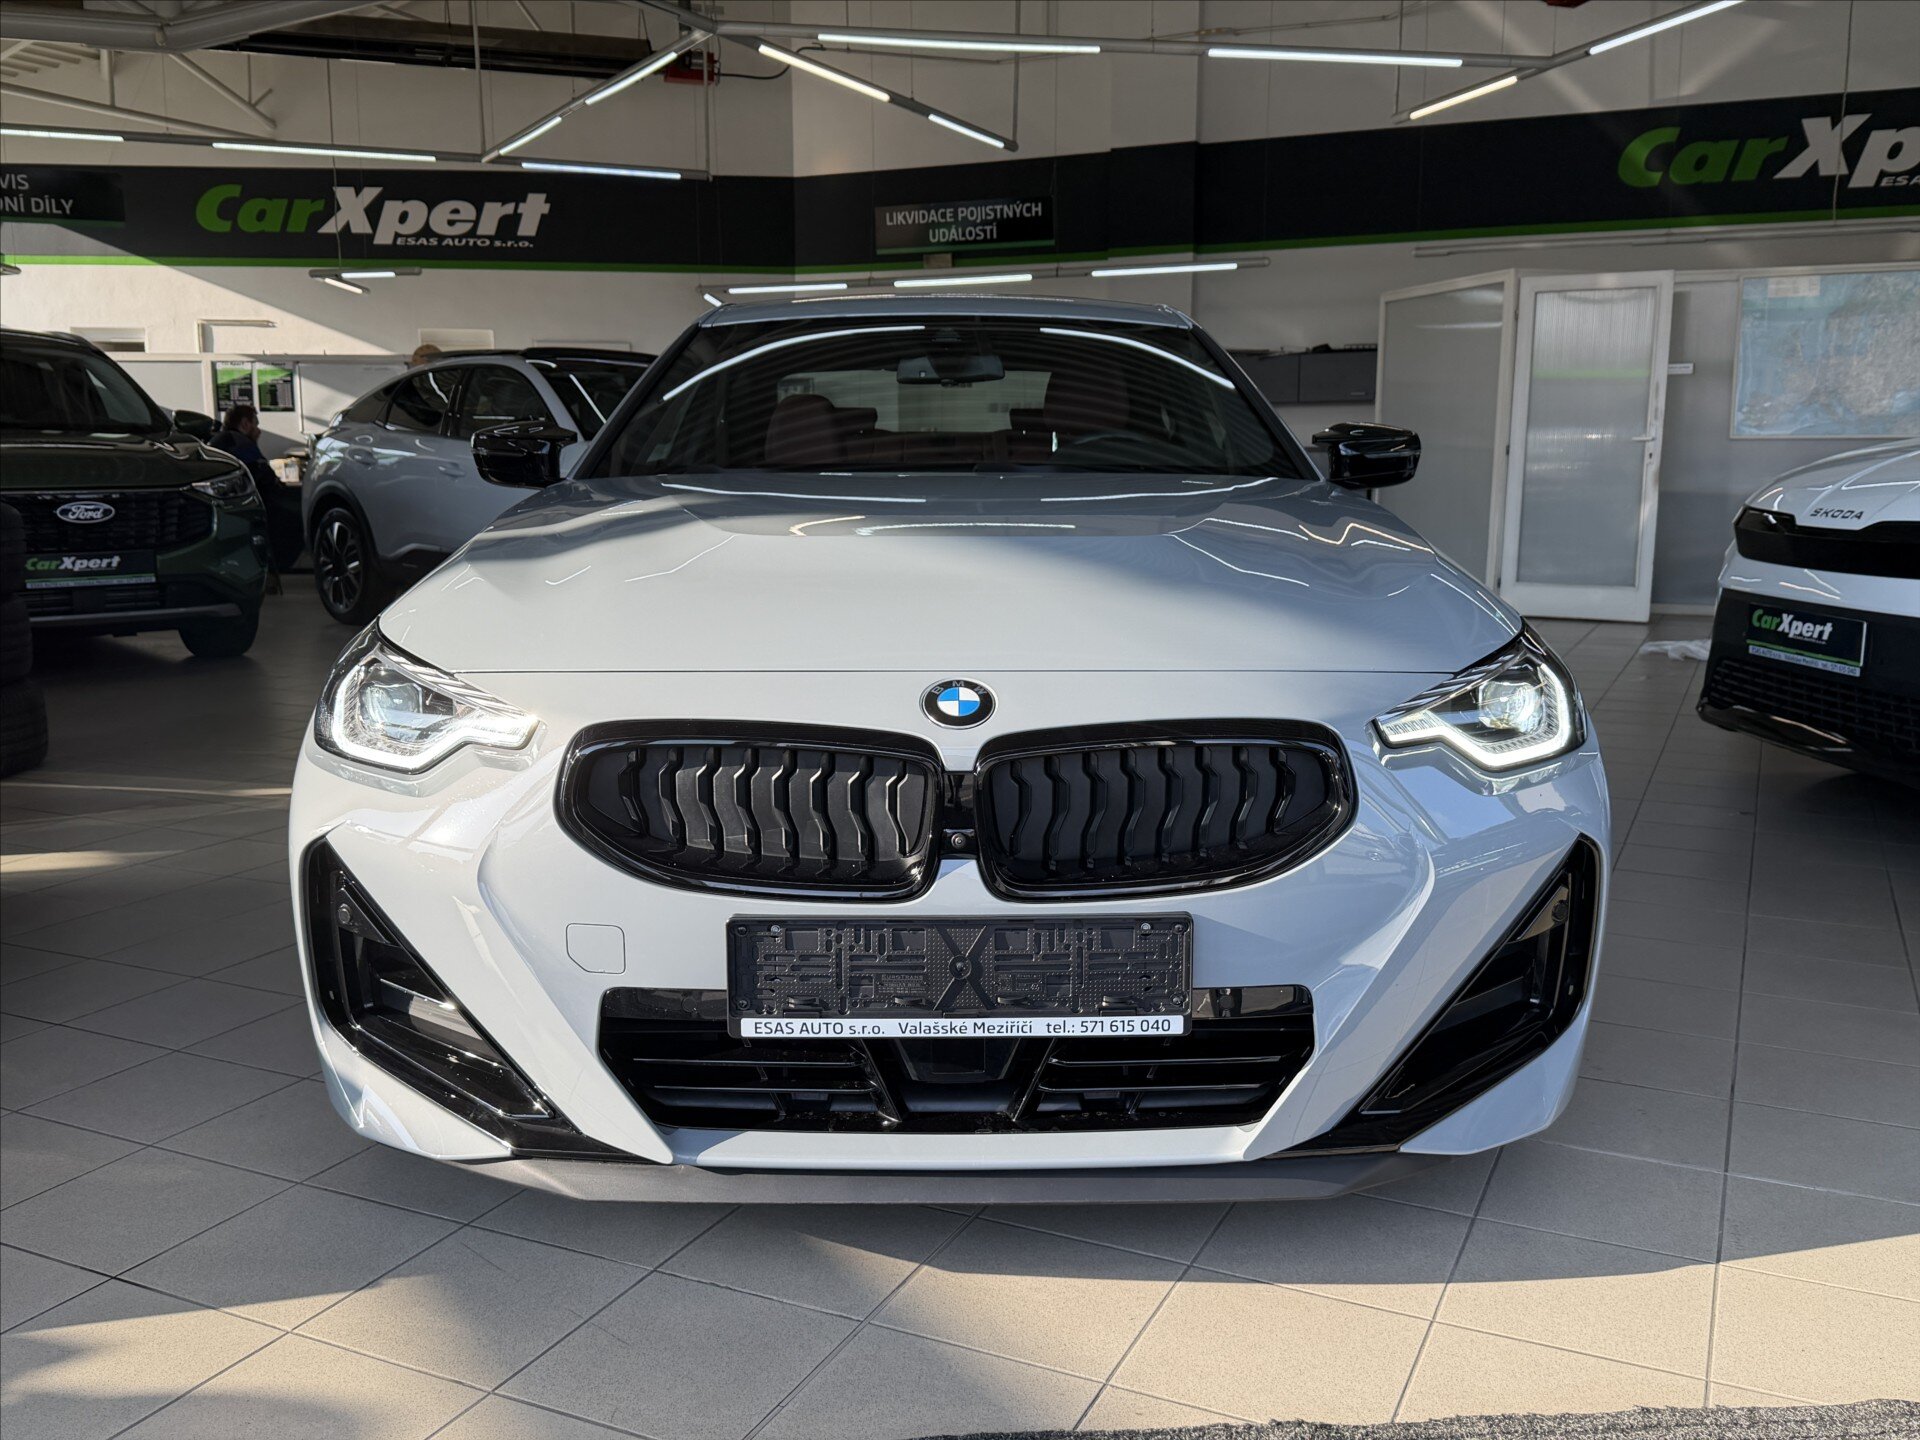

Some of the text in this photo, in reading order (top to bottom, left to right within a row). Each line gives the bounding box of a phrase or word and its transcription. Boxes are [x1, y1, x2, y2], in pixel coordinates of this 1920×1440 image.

[0, 194, 73, 215] NÍ DÍLY
[195, 184, 550, 245] CarXpert
[886, 201, 1042, 226] LIKVIDACE POJISTNÝCH
[396, 237, 533, 248] ESAS AUTO s.r.o.
[929, 223, 997, 243] UDÁLOSTÍ
[25, 555, 121, 571] CarXpert
[1752, 608, 1833, 640] CarXpert
[931, 681, 988, 695] BMW
[754, 1018, 1171, 1035] ESAS AUTO s.r.o. Valašské Meziříčí tel.: 571 615 040
